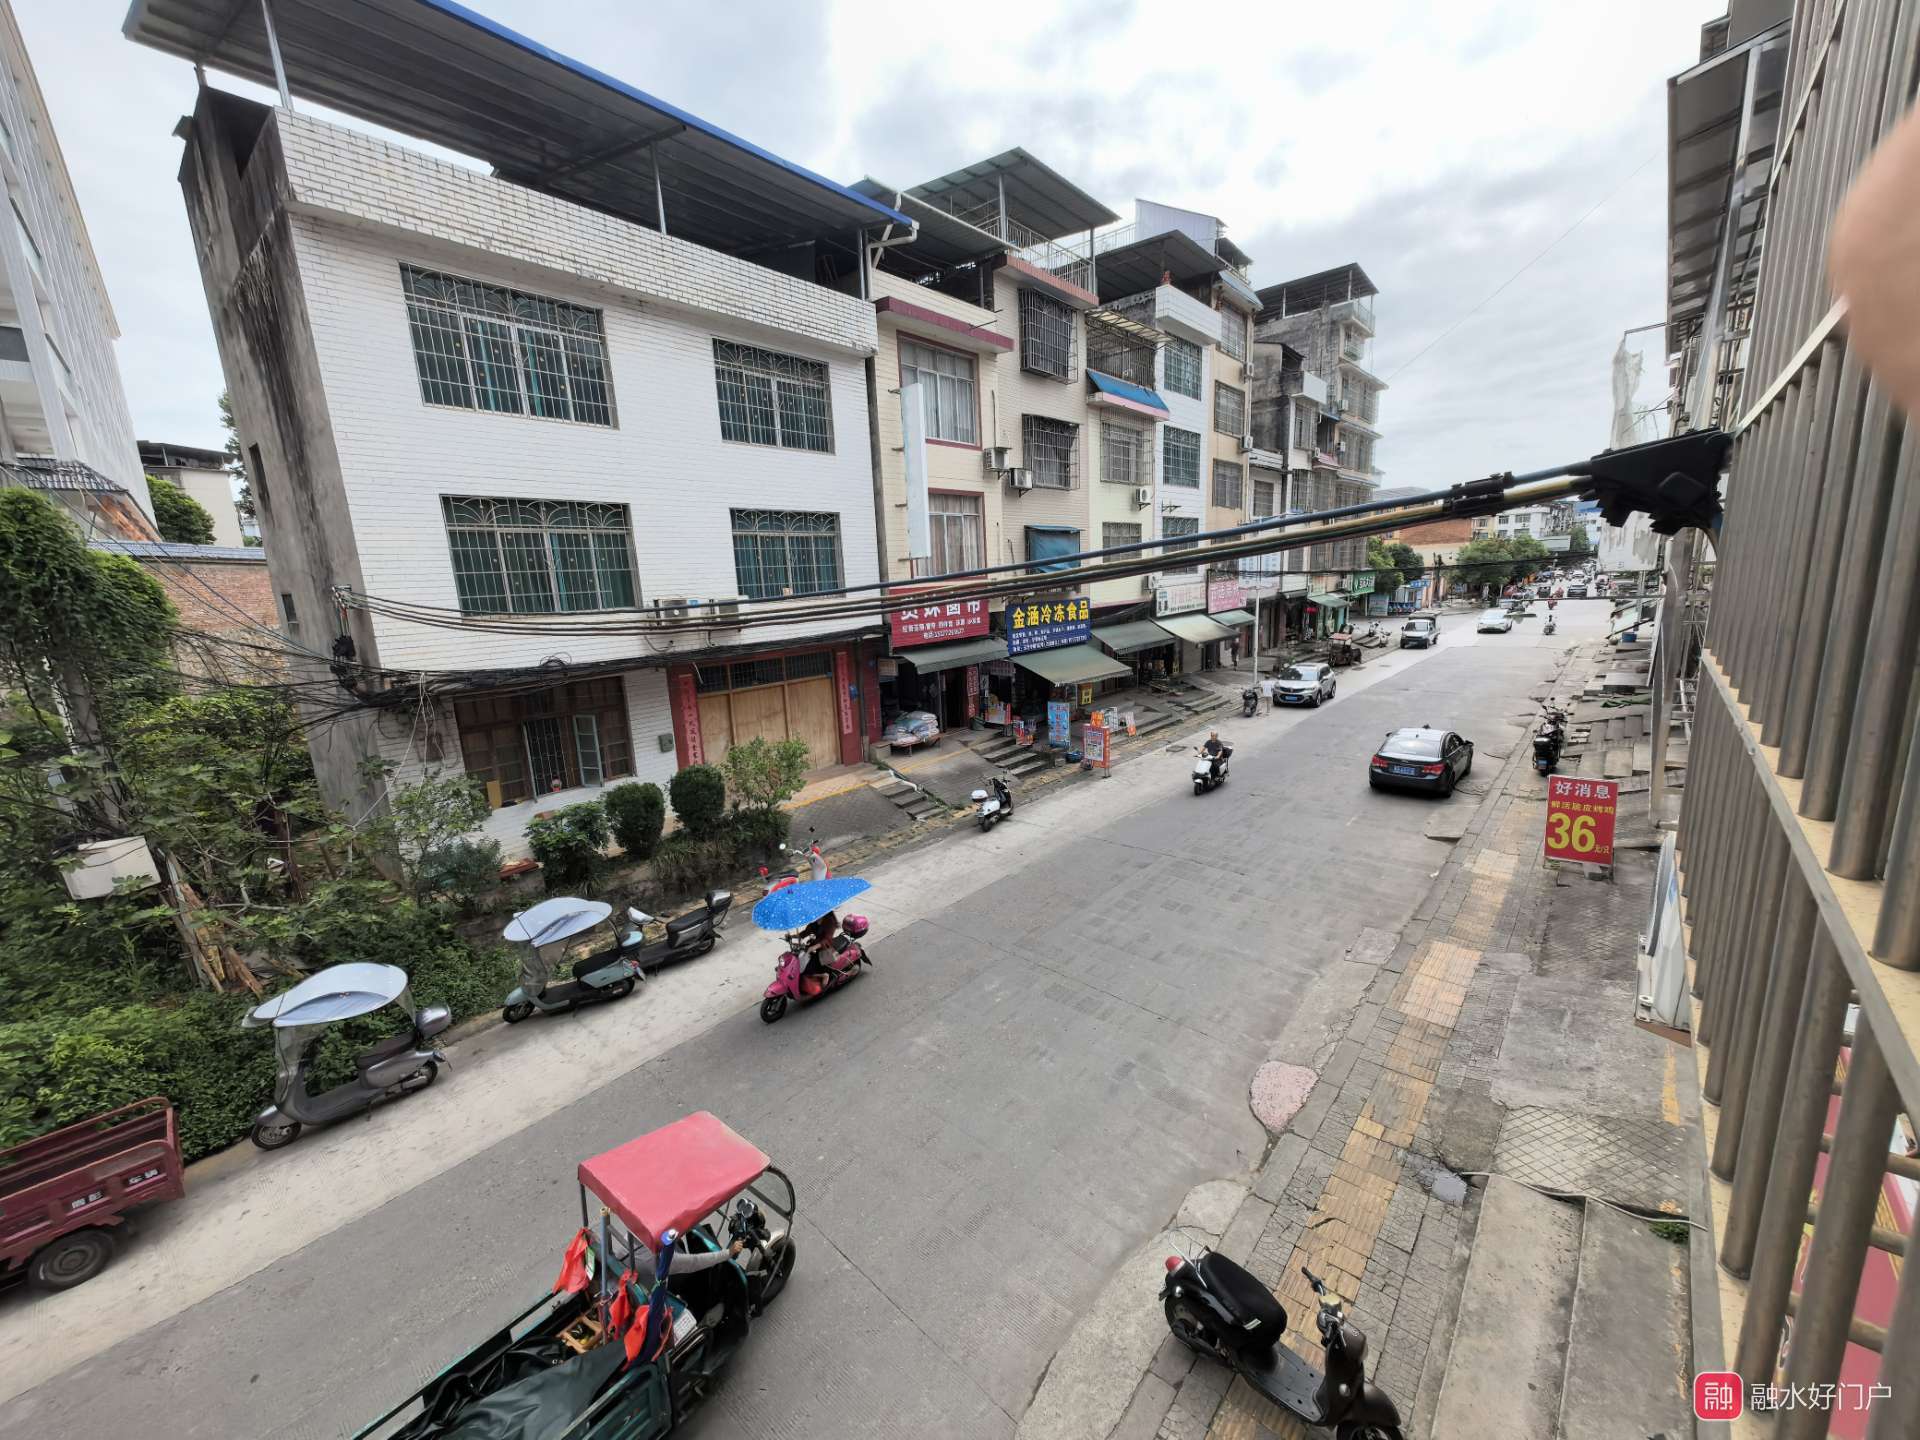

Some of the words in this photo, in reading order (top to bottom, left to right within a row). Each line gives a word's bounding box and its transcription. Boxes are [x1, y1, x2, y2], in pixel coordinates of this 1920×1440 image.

[1012, 600, 1088, 628] 金涵冷冻食品
[1556, 781, 1609, 798] 好消息
[1548, 813, 1595, 852] 36
